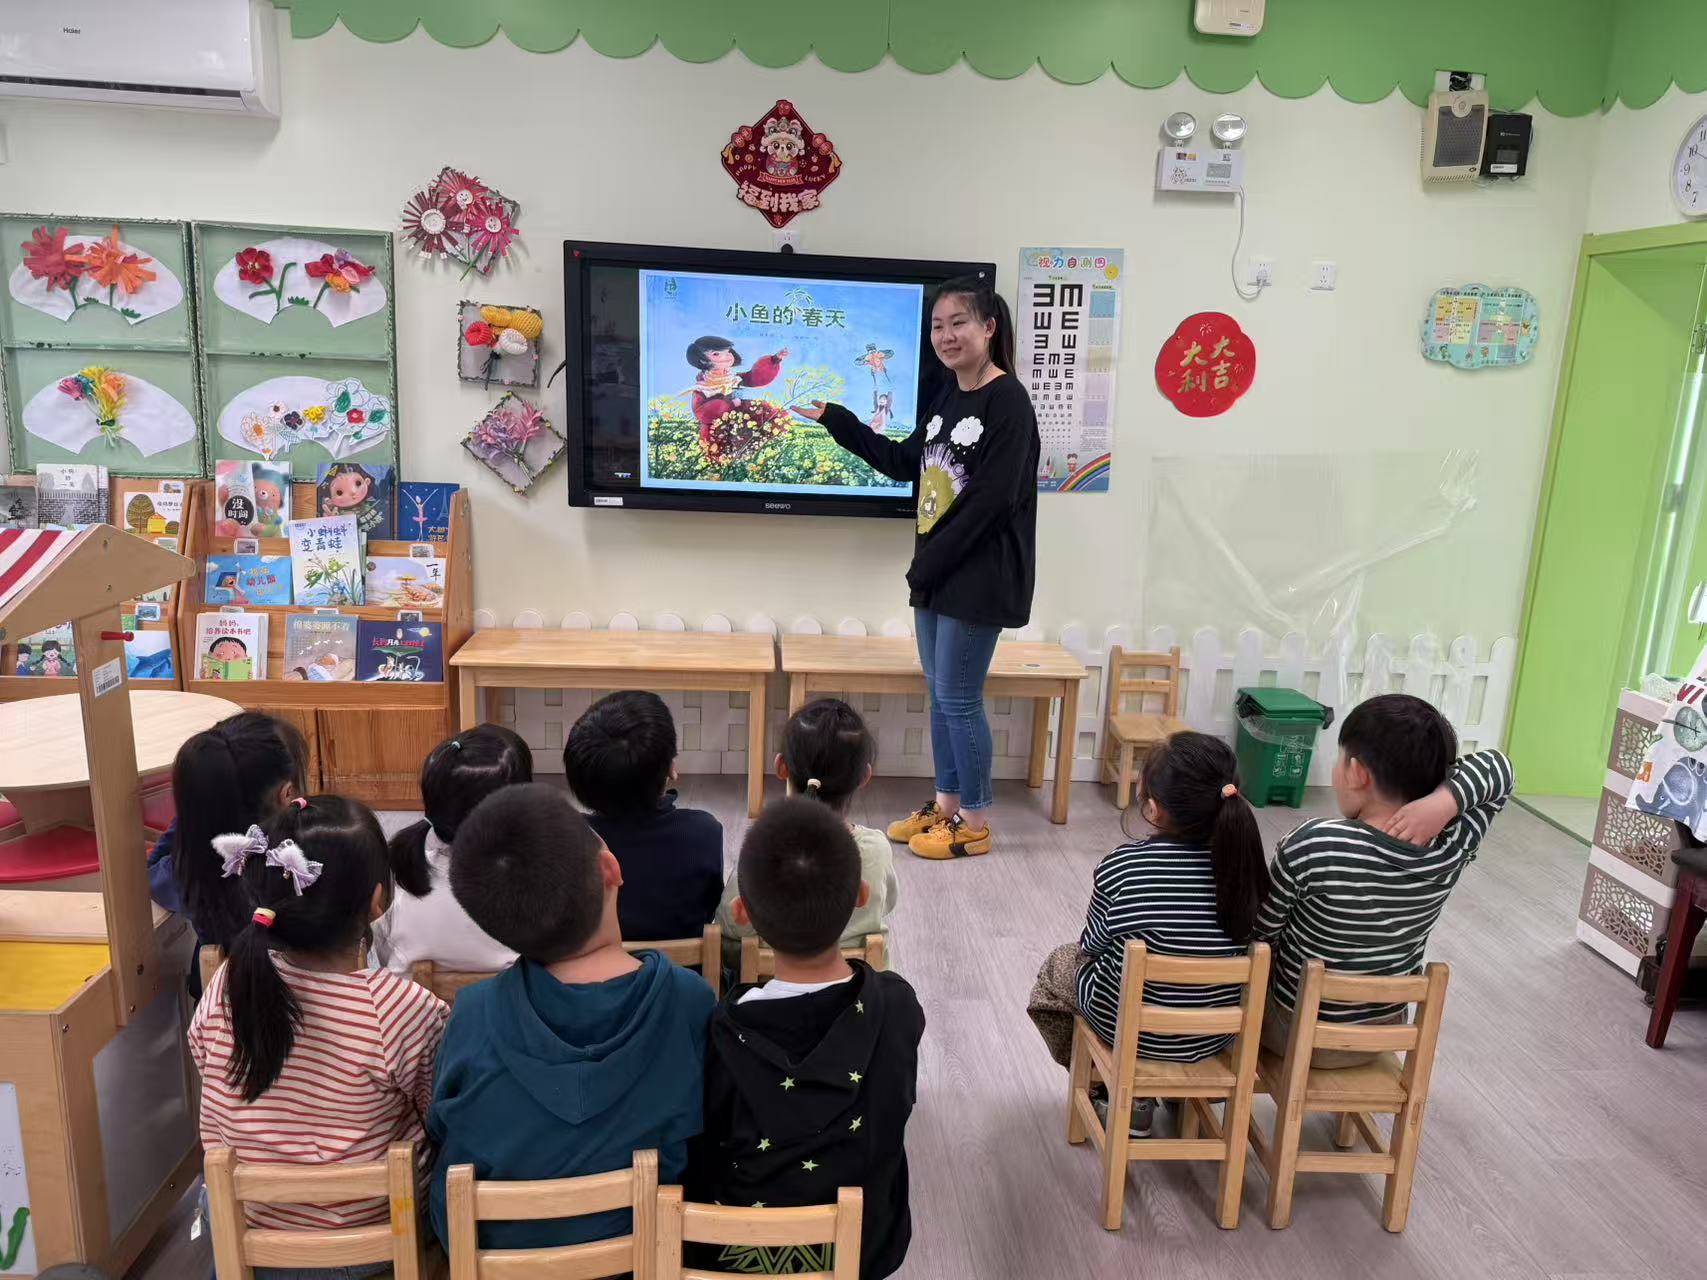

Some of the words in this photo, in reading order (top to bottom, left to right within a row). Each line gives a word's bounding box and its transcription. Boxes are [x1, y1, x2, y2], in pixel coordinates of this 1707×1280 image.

[1689, 144, 1698, 158] 10
[1684, 163, 1691, 176] 9
[1685, 179, 1692, 193] 8
[1039, 256, 1106, 269] 视力自测图
[726, 302, 846, 329] 小鱼的春天
[232, 498, 244, 510] 没
[227, 509, 249, 519] 时间
[306, 523, 348, 537] 小蝌蚪
[301, 536, 343, 552] 变青蛙
